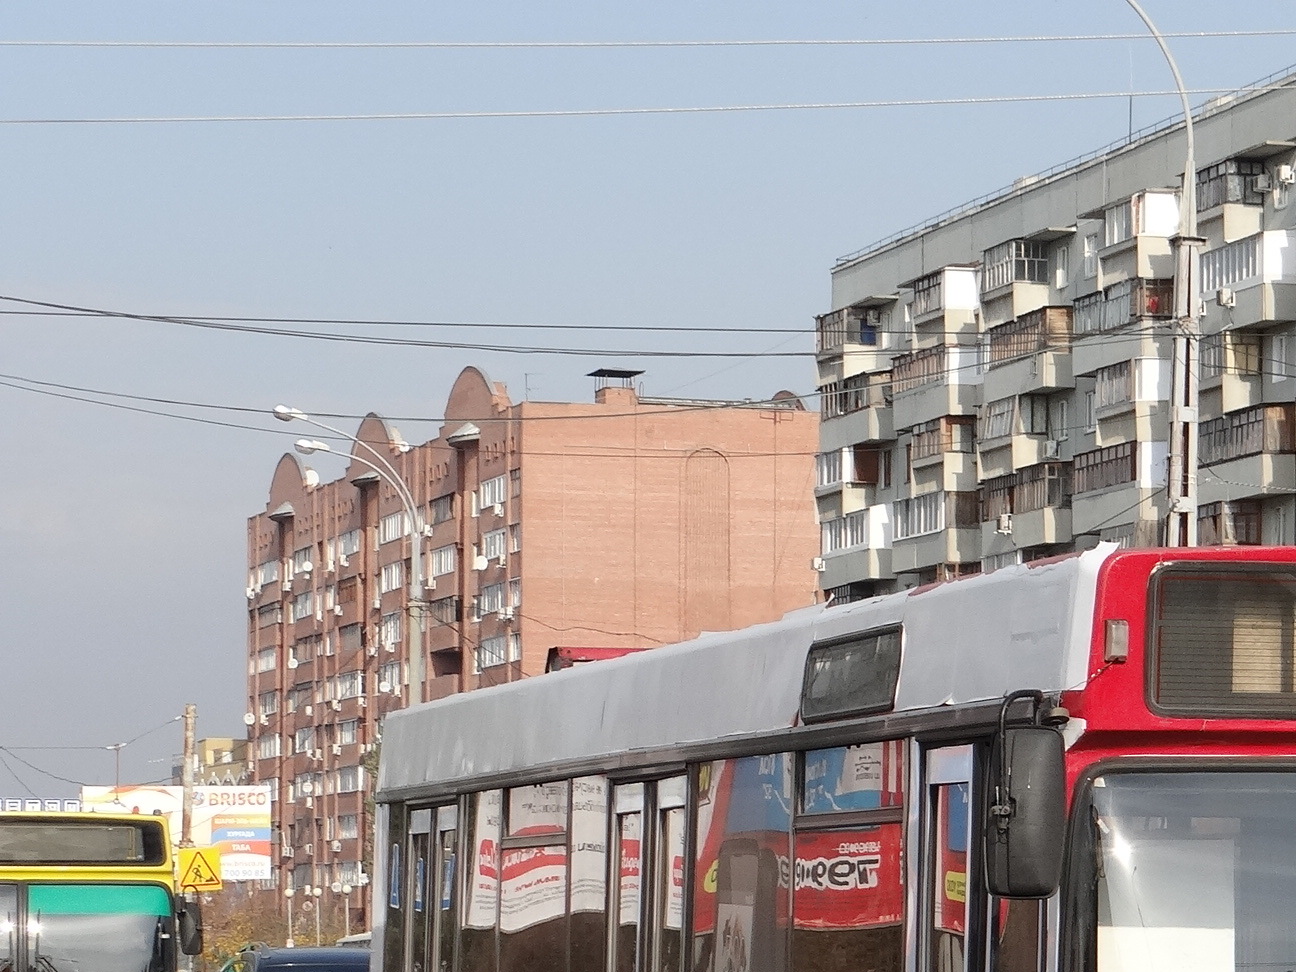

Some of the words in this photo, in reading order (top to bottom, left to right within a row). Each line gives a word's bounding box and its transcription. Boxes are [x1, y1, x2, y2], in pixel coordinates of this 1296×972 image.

[209, 792, 266, 806] BRISCO
[225, 869, 240, 877] 700
[242, 869, 252, 877] 90
[254, 869, 265, 877] 85
